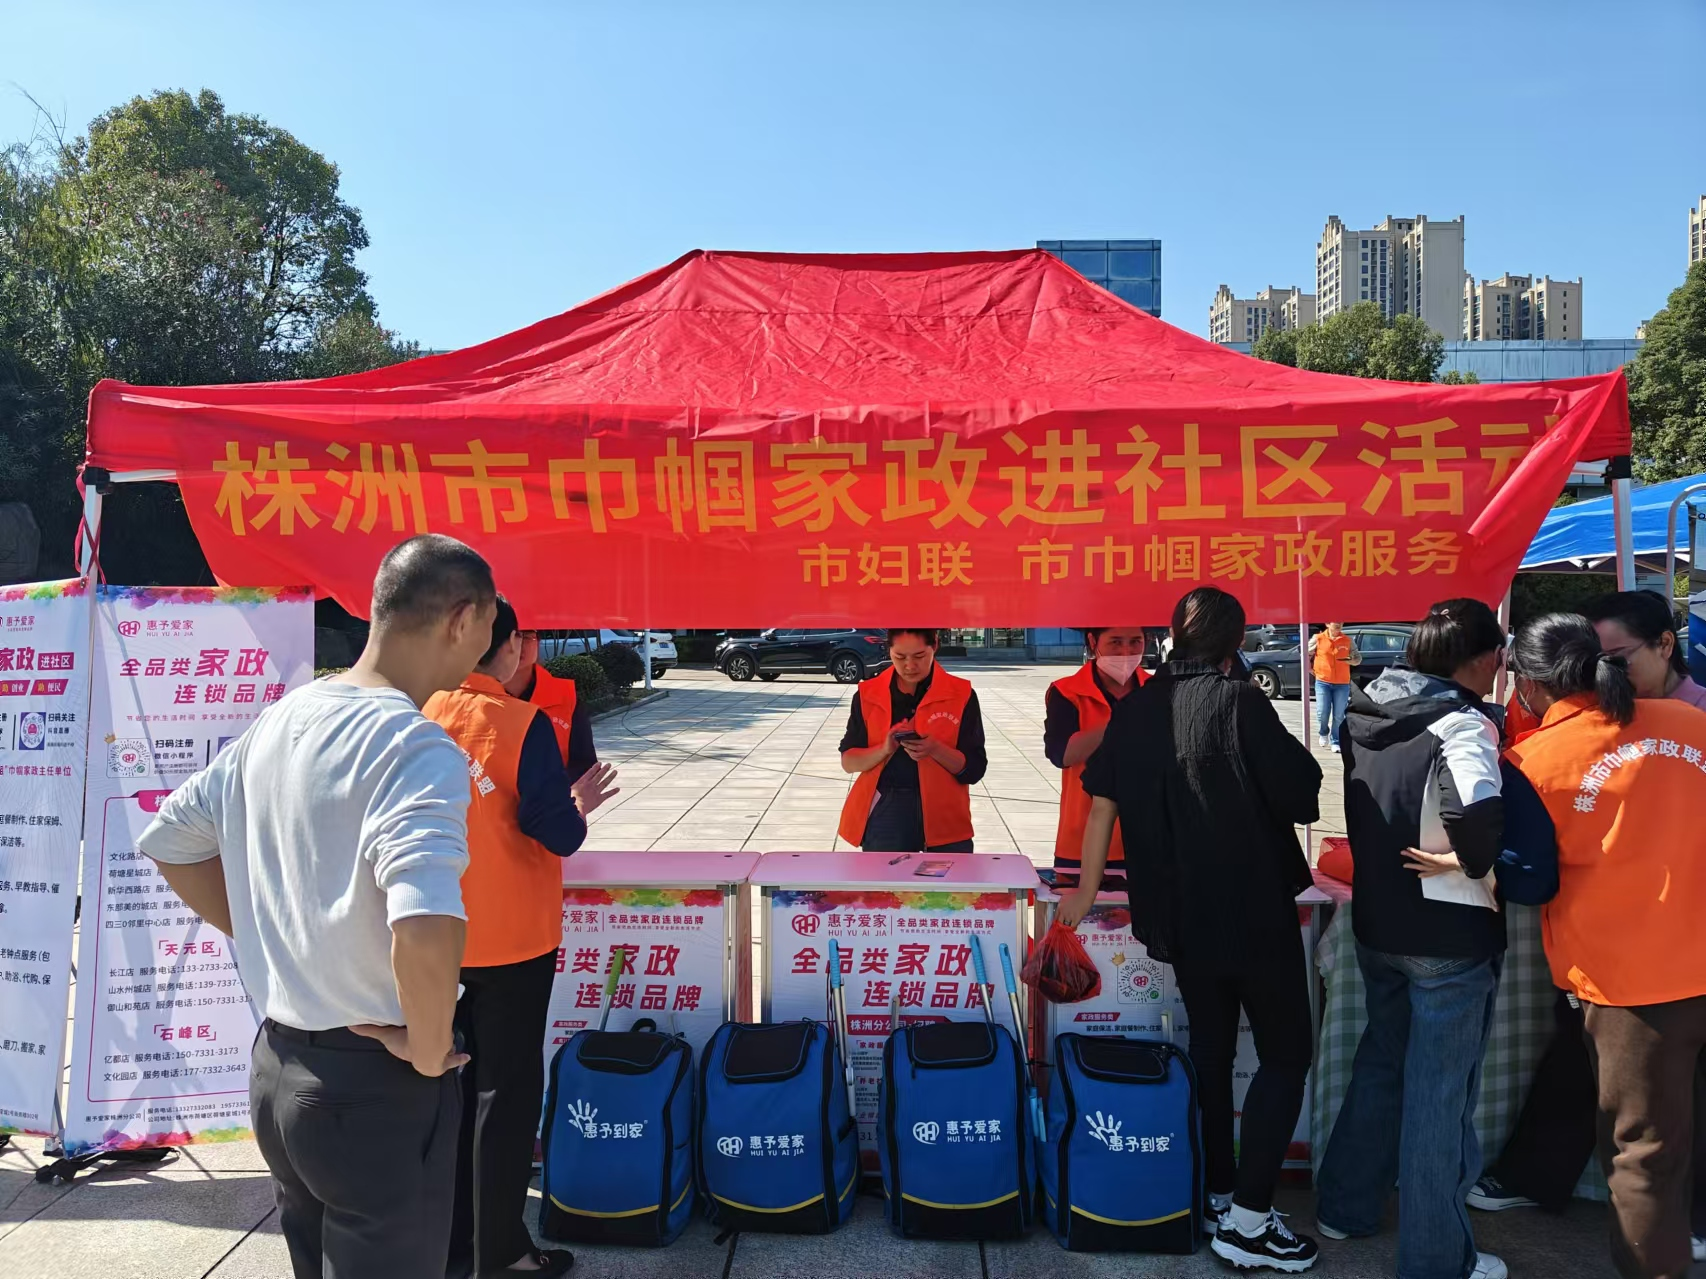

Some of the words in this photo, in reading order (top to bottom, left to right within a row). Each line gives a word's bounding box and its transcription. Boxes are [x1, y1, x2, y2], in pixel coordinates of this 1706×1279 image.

[798, 542, 972, 587] 市妇联
[1017, 527, 1463, 585] 市巾帼家政服务
[146, 620, 194, 631] 惠予爱家
[41, 655, 71, 668] 进社区
[120, 648, 270, 676] 全品类家政
[174, 682, 286, 704] 连锁品牌
[48, 713, 75, 722] 扫码关注
[155, 739, 194, 748] 扫码注册
[154, 752, 194, 760] 微信小程序
[110, 852, 145, 861] 文化路店
[108, 868, 152, 878] 荷塘星城店
[108, 885, 151, 895] 新华西路店
[106, 901, 158, 912] 东部美的城店
[176, 916, 210, 926] 服务电
[608, 914, 704, 925] 全品类家政连锁品牌
[828, 914, 887, 928] 惠予爱家
[897, 918, 995, 929] 全品类家政连锁品牌
[791, 943, 973, 976] 全品类家政
[109, 967, 134, 977] 长江店
[108, 985, 151, 995] 山水州城店
[862, 981, 995, 1009] 连锁品牌
[574, 983, 702, 1011] 连锁品牌
[107, 1001, 150, 1012] 御山和苑店
[104, 1054, 130, 1064] 亿都店
[103, 1071, 138, 1081] 文化园店
[583, 1122, 644, 1139] 惠予到家
[945, 1119, 1001, 1135] 惠予爱家
[749, 1134, 805, 1149] 惠予爱家
[990, 1134, 1001, 1143] JIA
[1109, 1135, 1171, 1152] 惠予到家
[793, 1148, 805, 1157] JIA
